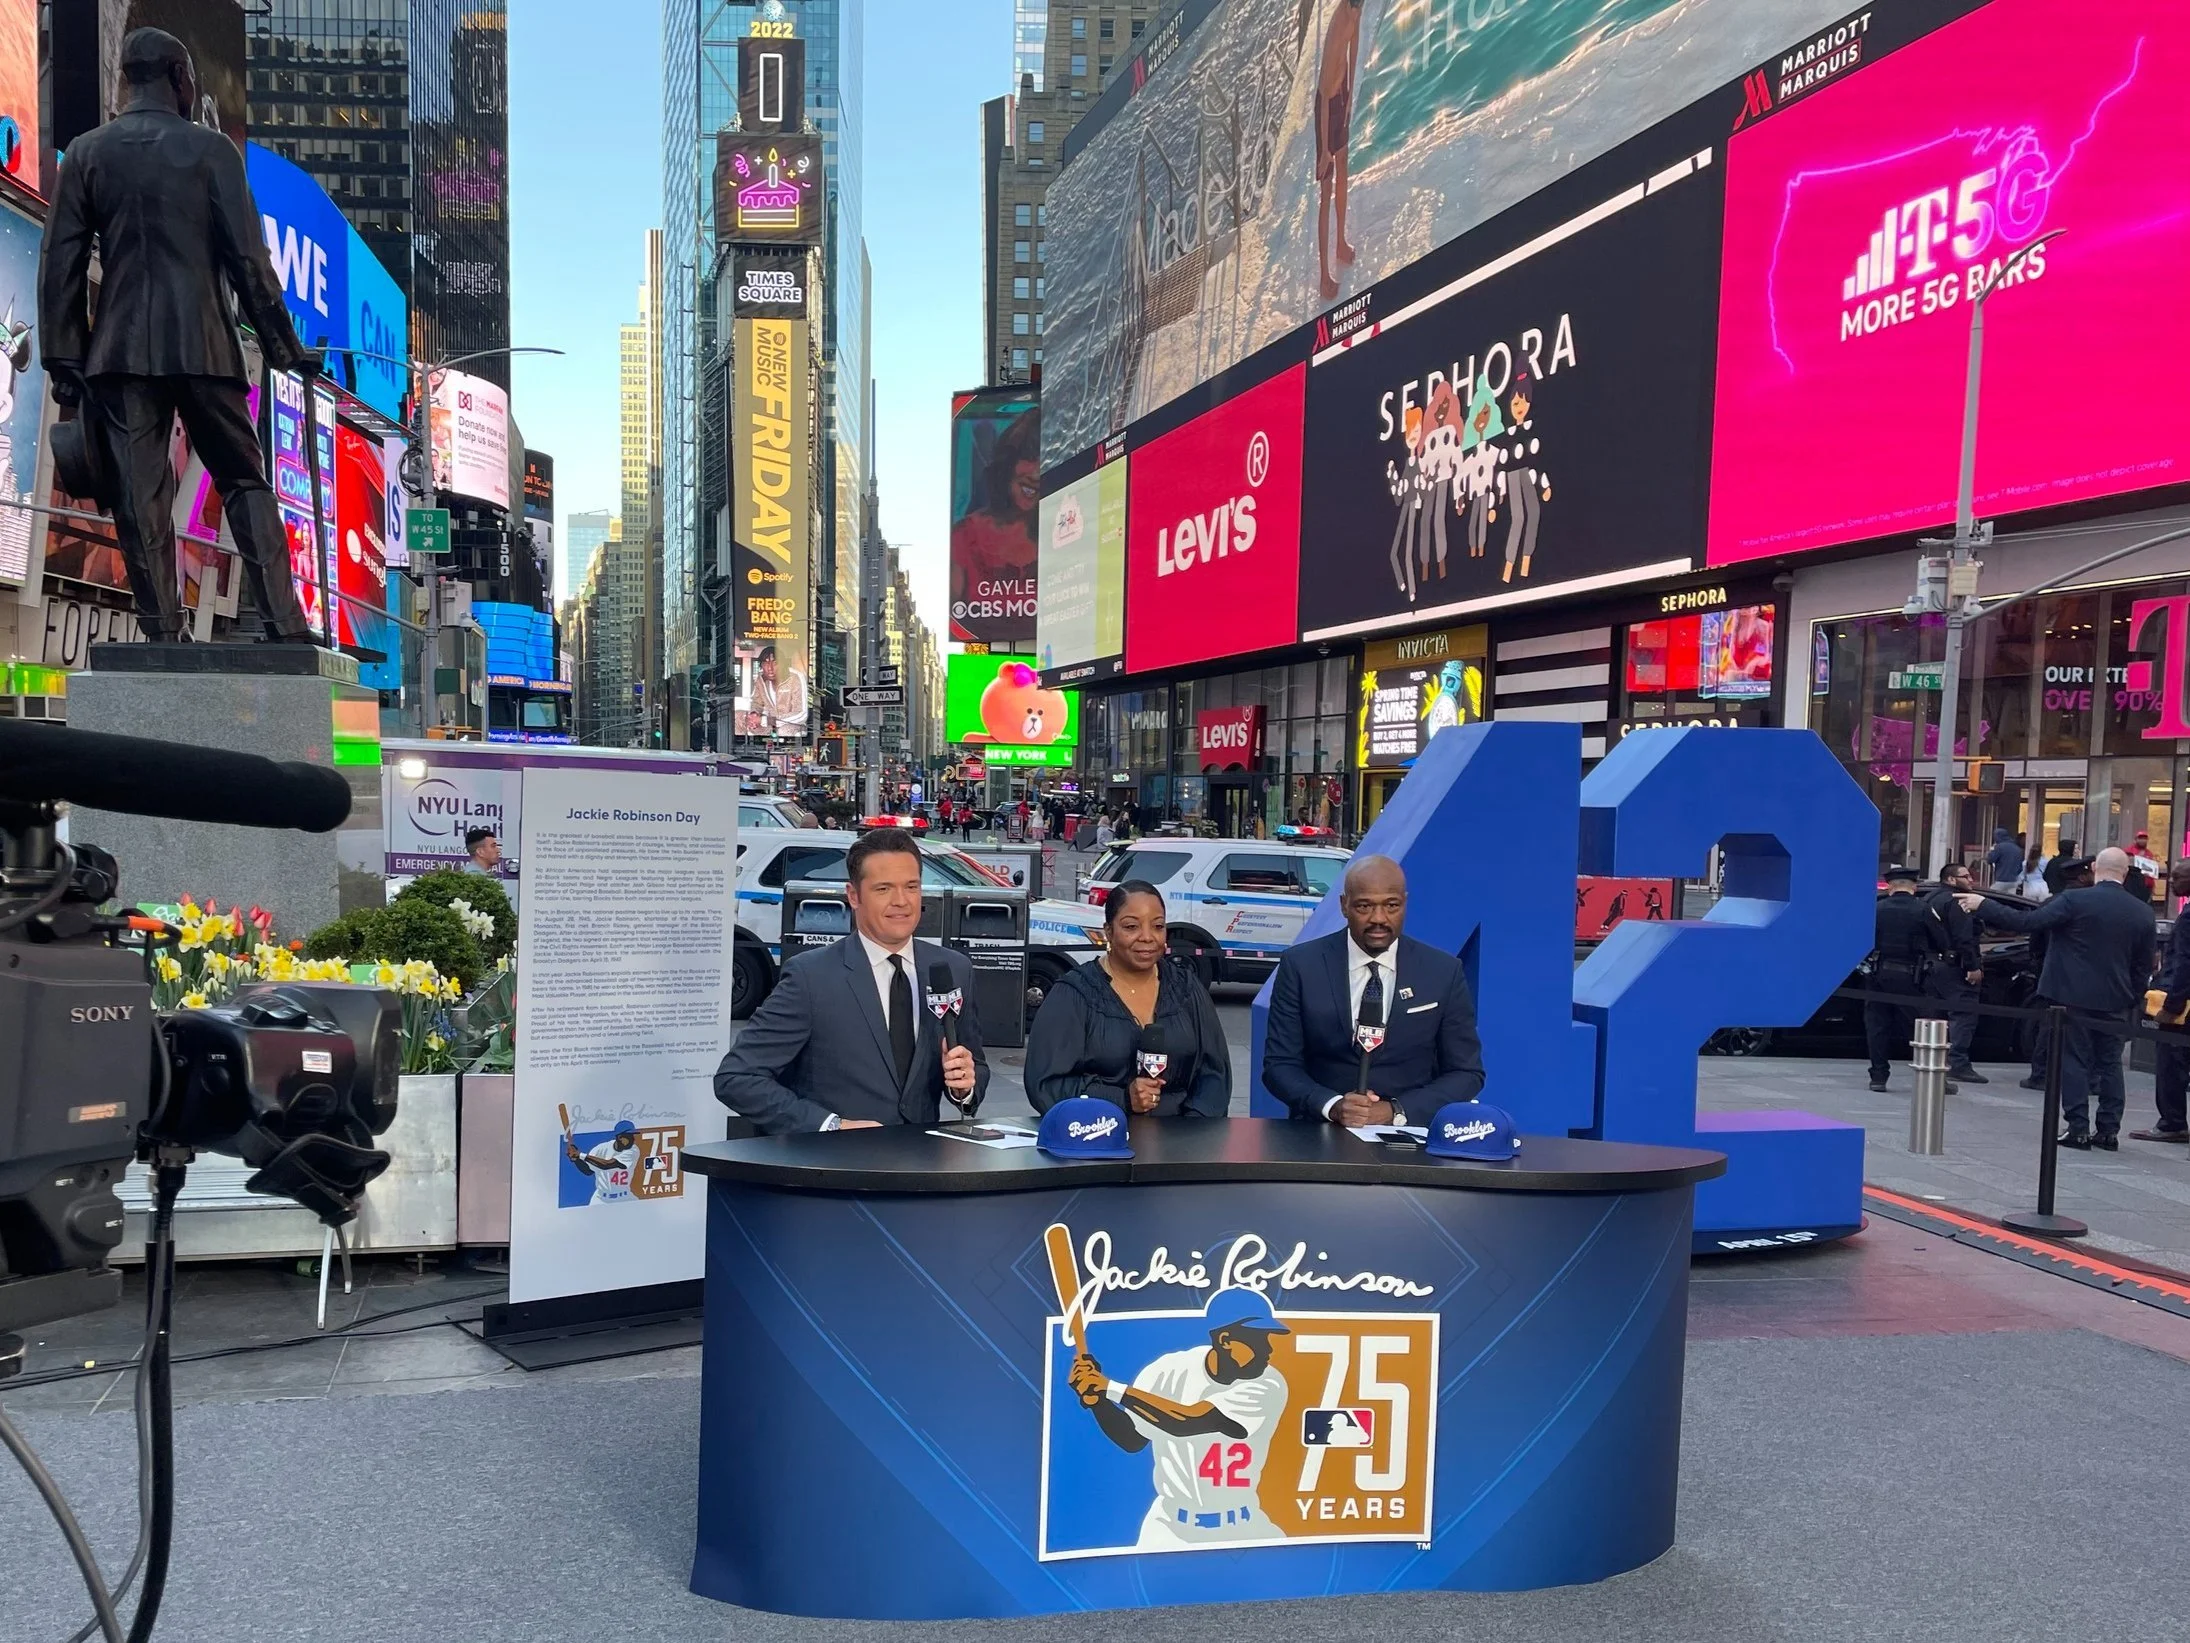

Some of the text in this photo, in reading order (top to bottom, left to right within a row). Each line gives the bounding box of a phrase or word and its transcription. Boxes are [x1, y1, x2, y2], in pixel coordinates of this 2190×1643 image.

[750, 22, 794, 38] 2022
[1149, 10, 1184, 58] MARRIOTT
[1781, 12, 1871, 76] MARRIOTT
[1148, 34, 1179, 76] MARQUIS
[1780, 44, 1858, 98] MARQUIS
[263, 213, 328, 318] WE
[747, 271, 794, 286] TIMES
[739, 285, 802, 303] SQUARE
[1840, 243, 2047, 342] MORE 5G BARS
[1333, 293, 1372, 323] MARRIOTT
[1332, 312, 1366, 338] MARQUIS
[361, 299, 396, 388] CAN
[757, 327, 771, 387] MUSIC
[772, 349, 787, 393] NEW
[1379, 313, 1577, 441] SEPHORA
[458, 416, 485, 433] Donate
[487, 427, 498, 437] now
[458, 428, 476, 443] help
[478, 437, 486, 445] us
[752, 395, 791, 564] FRIDAY
[422, 514, 433, 523] TO
[412, 526, 419, 534] W
[420, 526, 434, 534] 45
[764, 572, 794, 583] Spotify
[978, 579, 1035, 596] GAYLE
[748, 598, 795, 611] FREDO
[1661, 587, 1727, 612] SEPHORA
[751, 611, 793, 625] BANG
[968, 601, 1003, 618] CBS
[1398, 634, 1449, 660] INVICTA
[882, 671, 894, 680] WAY
[1902, 675, 1912, 687] W
[1916, 675, 1930, 688] 46
[2045, 666, 2083, 683] OUR
[852, 692, 896, 701] ONE WAY
[1375, 686, 1418, 702] SPRING TIME
[2114, 691, 2163, 711] 90%
[1373, 700, 1417, 723] SAVINGS
[986, 750, 1047, 761] NEW YORK
[1401, 741, 1417, 754] FREE
[418, 797, 459, 815] NYU
[566, 808, 700, 825] Jackie Robinson Day
[417, 845, 436, 853] NYU
[1032, 919, 1067, 933] POLICE
[1252, 720, 1880, 1234] 42
[70, 1006, 134, 1022] SONY
[1360, 1026, 1385, 1036] MLB
[1145, 1054, 1166, 1064] MLB
[620, 1103, 686, 1120] Robinson
[1068, 1116, 1118, 1141] Brooklyn
[1444, 1120, 1496, 1142] Brooklyn
[642, 1131, 678, 1185] 75
[611, 1171, 628, 1185] 42
[642, 1184, 677, 1194] YEARS
[1064, 1231, 1433, 1332] Jackie Robinson
[1296, 1335, 1410, 1492] 75
[1199, 1442, 1252, 1488] 42
[1297, 1497, 1405, 1520] YEARS
[1416, 1542, 1431, 1551] TM
